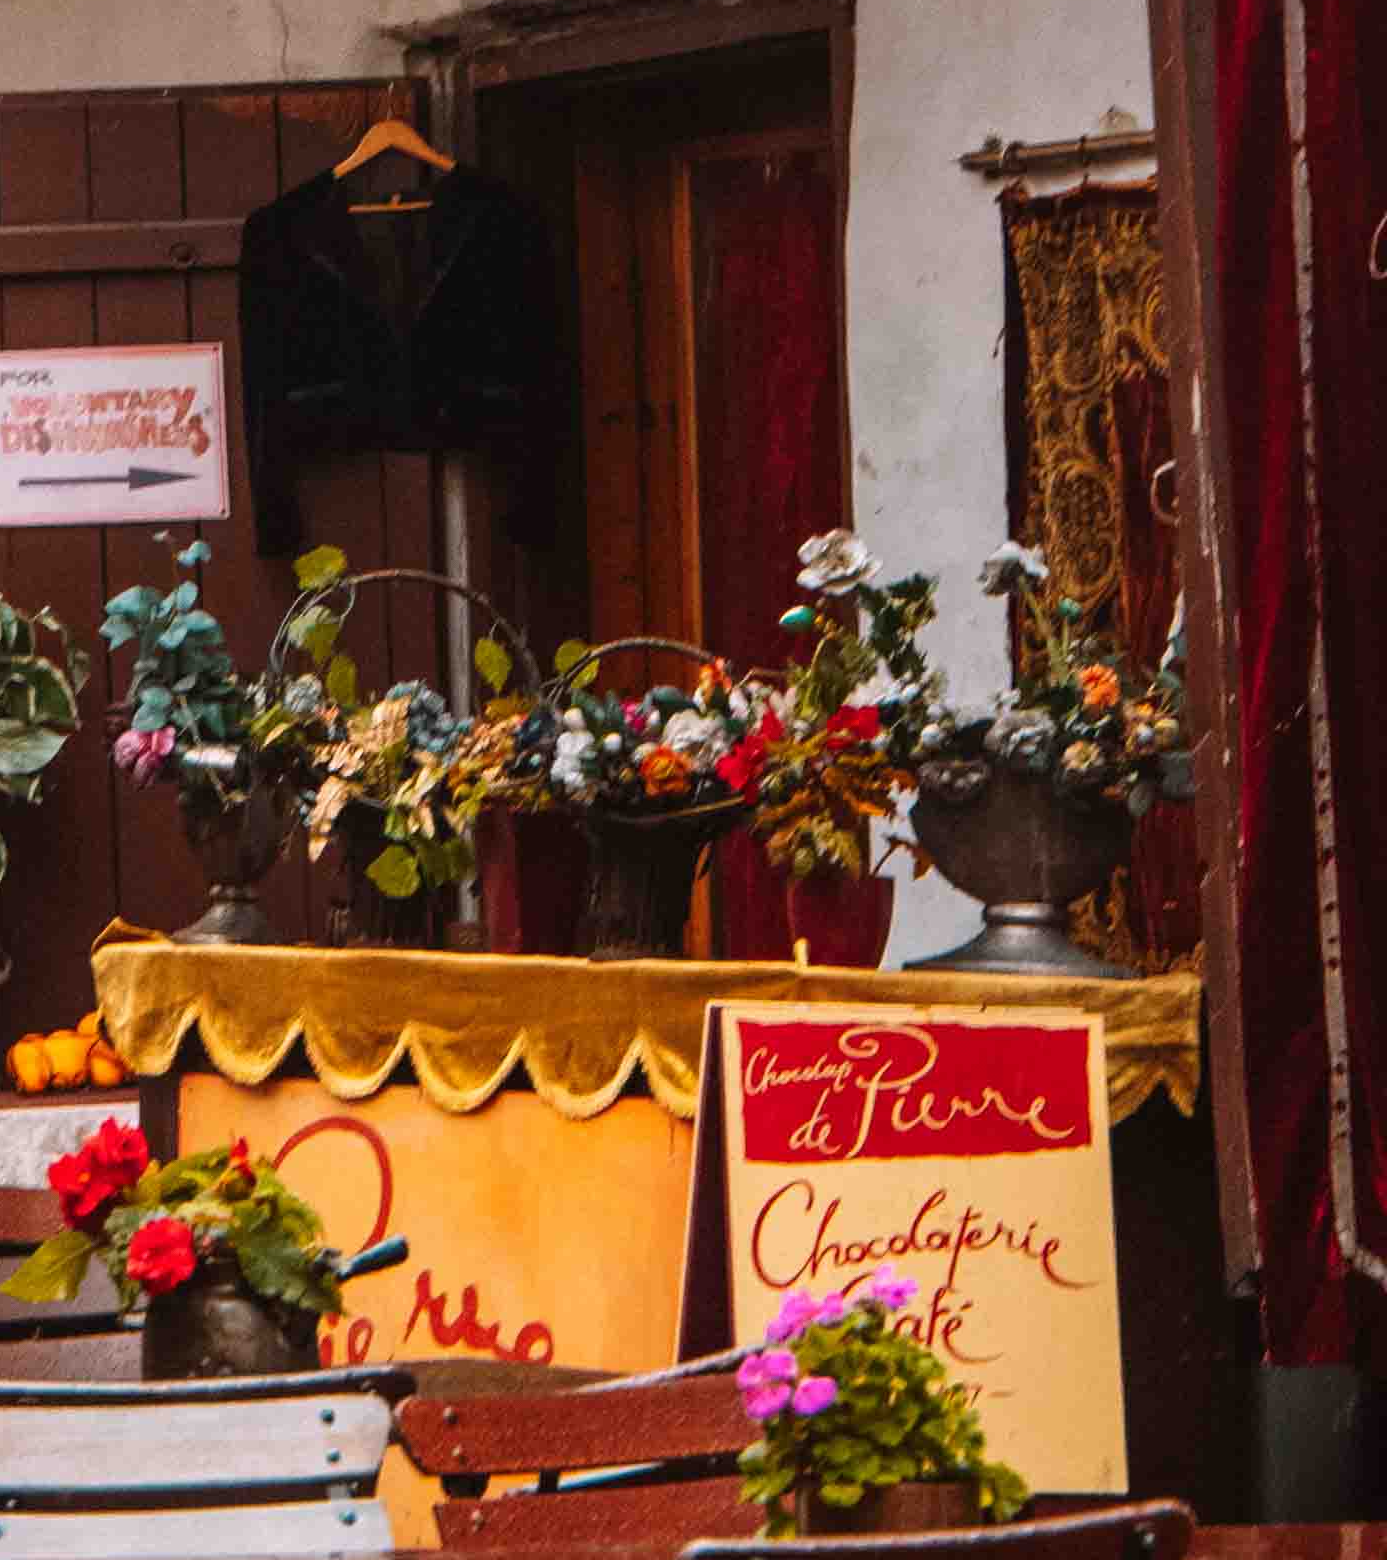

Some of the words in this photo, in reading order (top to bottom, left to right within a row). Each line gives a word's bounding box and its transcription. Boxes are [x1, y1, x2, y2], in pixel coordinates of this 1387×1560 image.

[838, 1023, 1076, 1159] Pierre
[751, 1178, 1099, 1290] Chocolaterie
[839, 1271, 1005, 1364] afé
